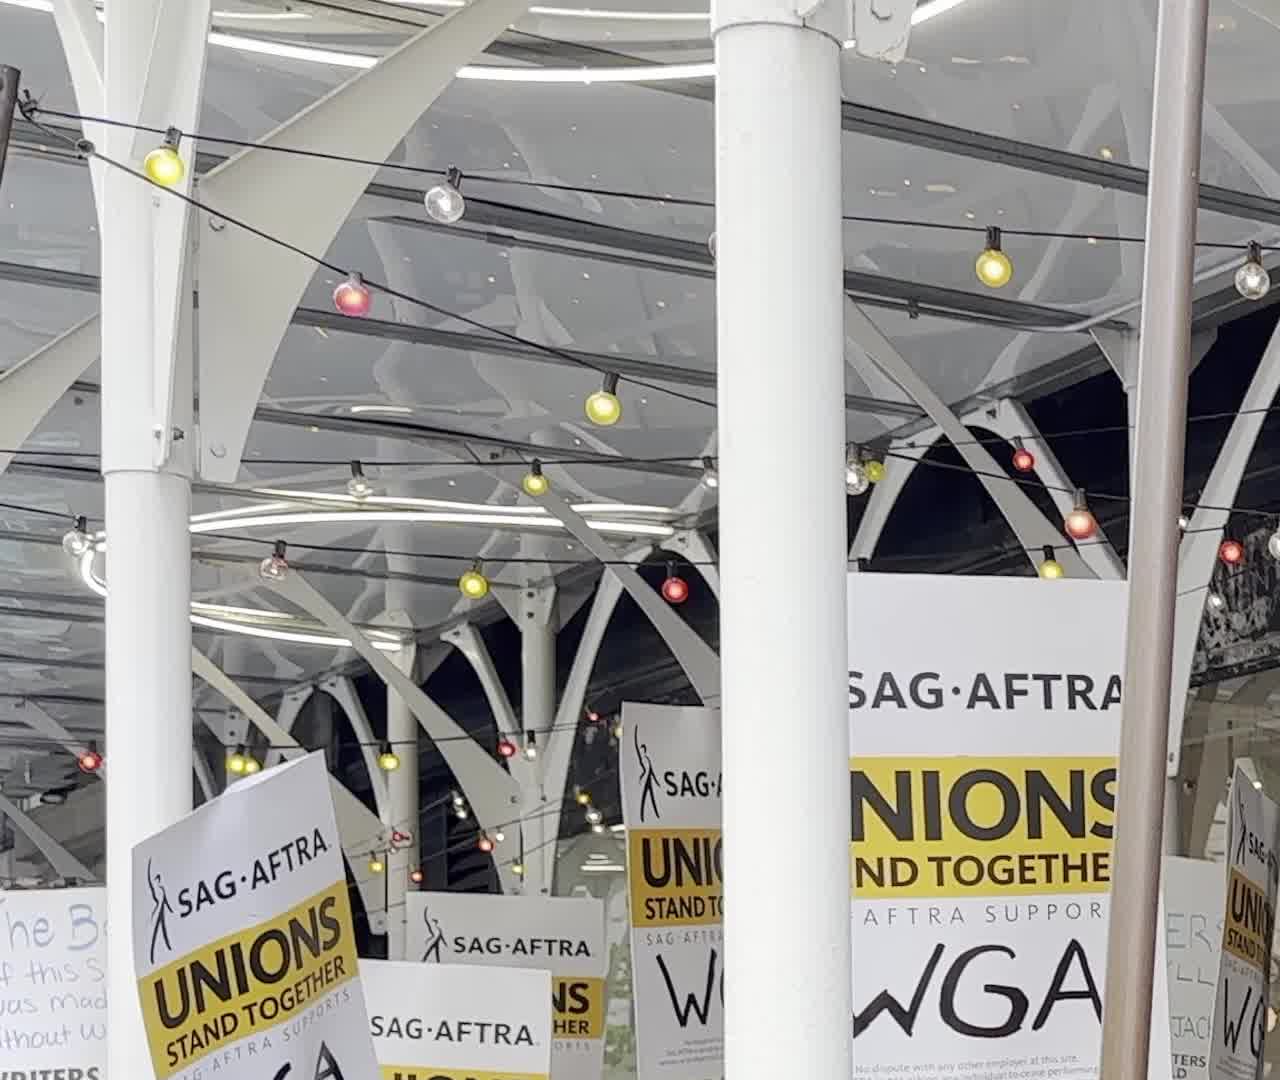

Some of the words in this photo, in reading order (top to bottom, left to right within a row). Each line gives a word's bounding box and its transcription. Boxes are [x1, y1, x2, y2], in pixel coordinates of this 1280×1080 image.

[641, 837, 723, 888] UNI
[927, 852, 1110, 886] TOGETHE
[645, 897, 705, 920] STAND
[154, 896, 341, 1030] UNIONS
[853, 938, 1102, 1038] WGA
[166, 1011, 239, 1067] STAND
[242, 955, 346, 1026] TOGETHER
